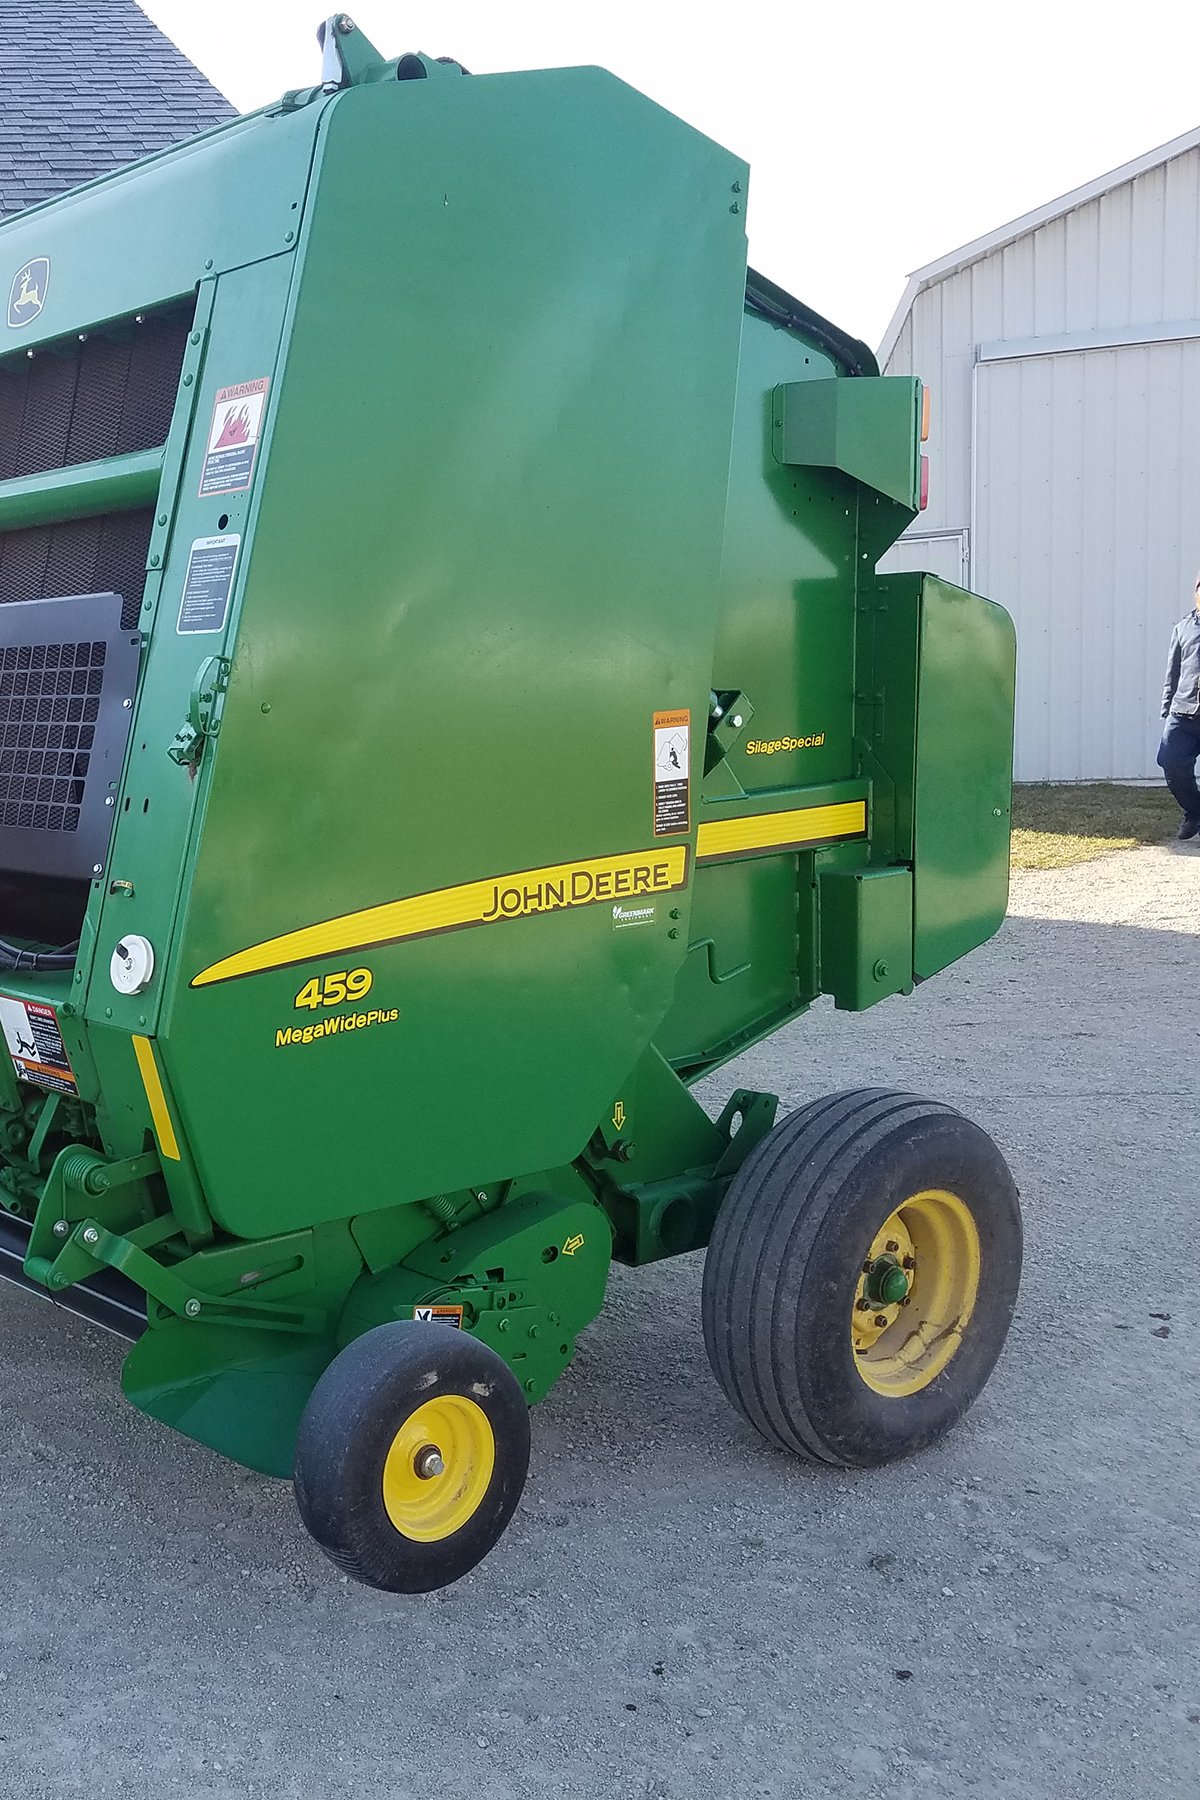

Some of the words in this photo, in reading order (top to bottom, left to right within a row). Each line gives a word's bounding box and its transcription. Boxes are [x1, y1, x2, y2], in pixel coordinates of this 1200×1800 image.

[227, 380, 264, 398] WARNING
[659, 714, 689, 725] WARNING
[745, 732, 825, 755] SilageSpecial
[483, 880, 564, 918] JOHN
[571, 863, 670, 901] DEERE
[618, 907, 655, 919] GREENMARK
[294, 967, 373, 1010] 459
[31, 1005, 53, 1017] DANGER
[275, 1008, 400, 1048] MegaWidePlus
